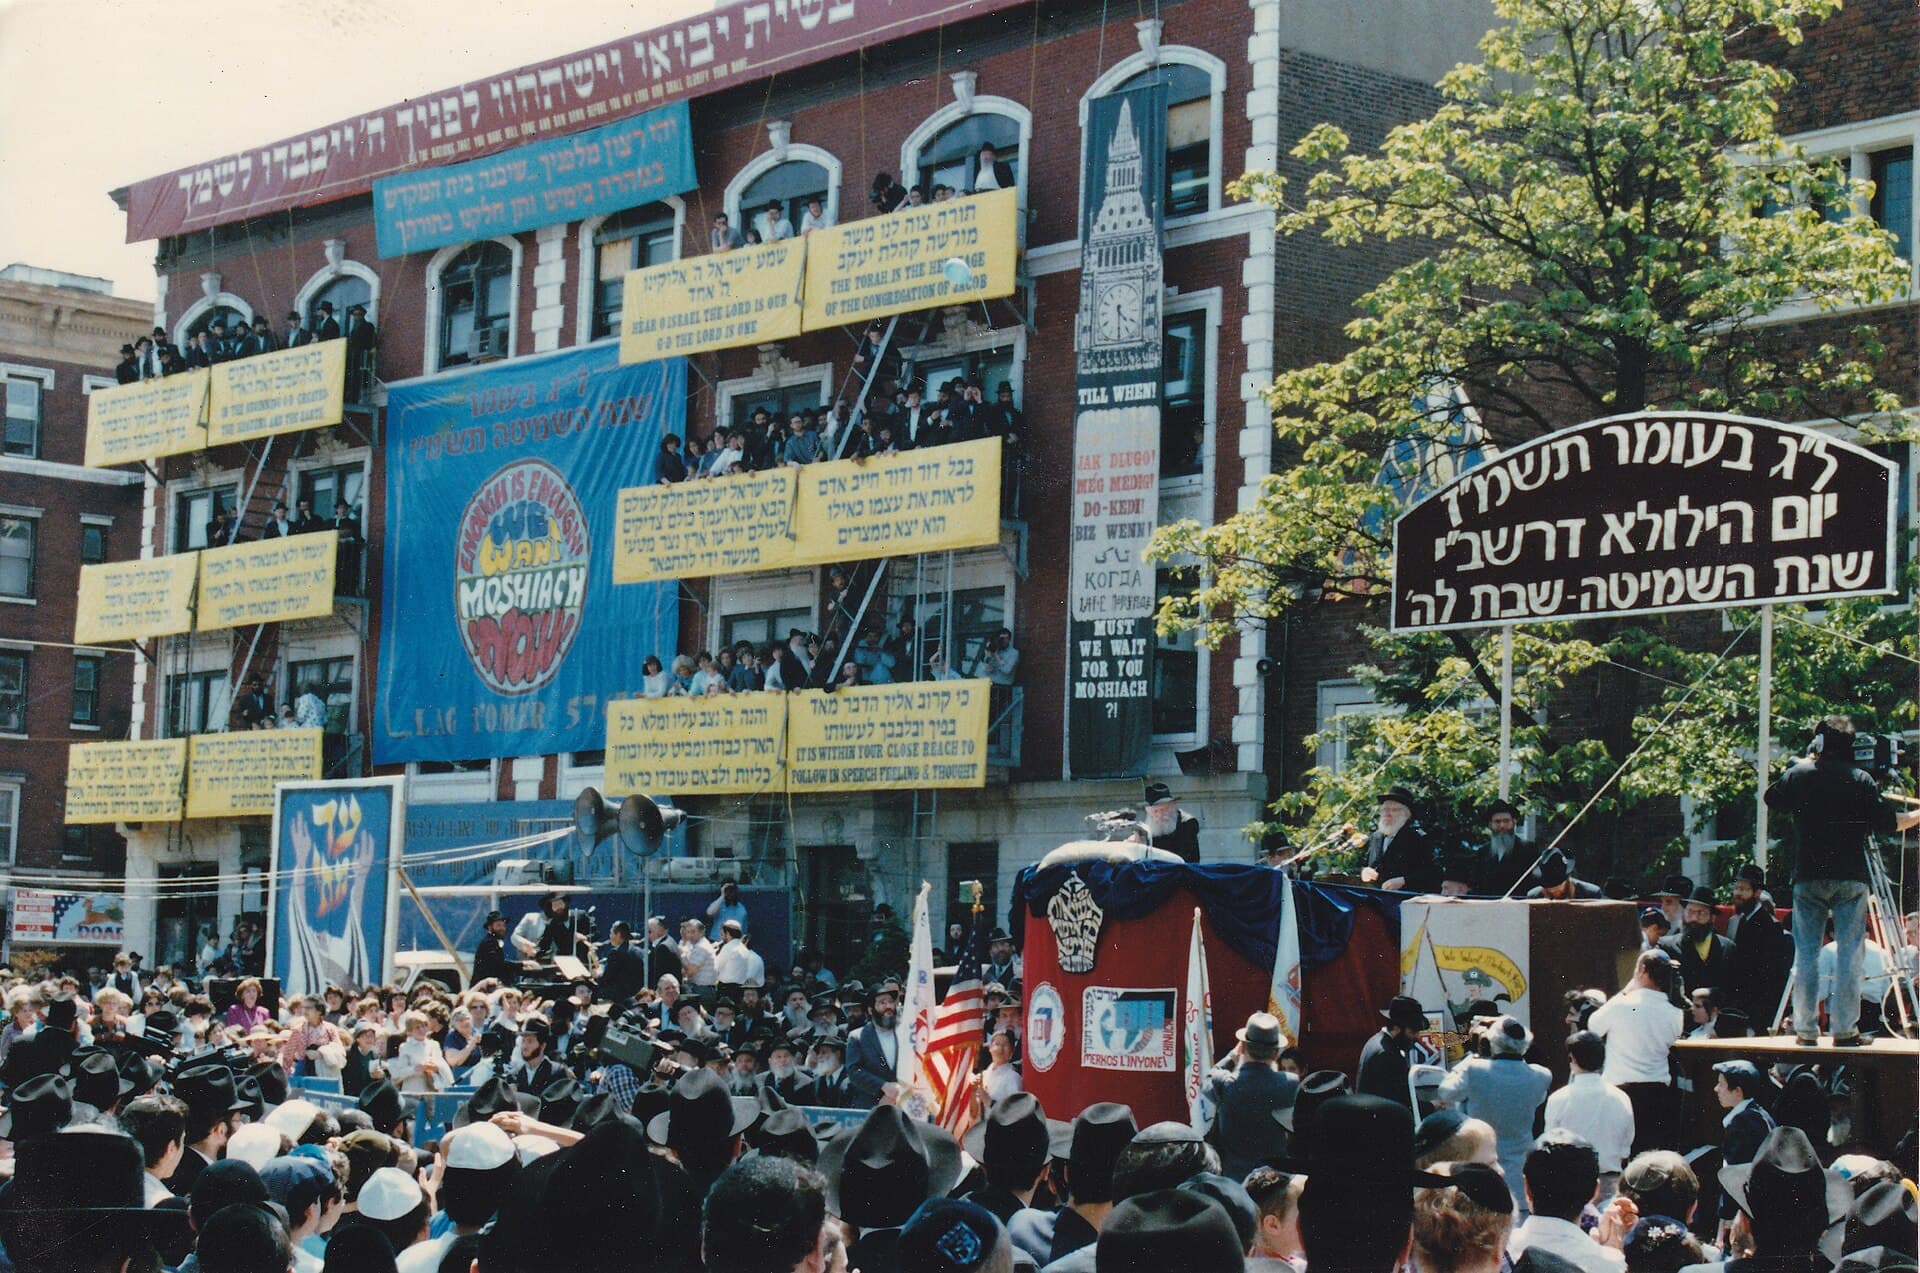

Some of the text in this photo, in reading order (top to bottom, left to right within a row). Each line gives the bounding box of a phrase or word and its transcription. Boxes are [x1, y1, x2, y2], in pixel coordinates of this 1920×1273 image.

[632, 15, 730, 80] יבואו
[489, 48, 625, 118] וישתחוו
[396, 83, 480, 164] לפניך
[261, 124, 355, 186] ויכבדו
[178, 150, 253, 220] לשמך
[842, 204, 977, 249] תורה צוה לנו משה
[926, 227, 979, 252] מורשה
[756, 246, 789, 270] שמע
[830, 251, 985, 295] THE TORAH IS THE HEAGE
[836, 249, 873, 273] יעקב
[631, 318, 657, 335] HEAR
[666, 310, 701, 329] ISRAEL
[703, 305, 723, 322] THE
[725, 300, 751, 319] LORD
[754, 298, 765, 313] IS
[767, 293, 788, 310] OUR
[825, 302, 838, 317] OF
[841, 297, 860, 314] THE
[863, 283, 935, 310] CONGREGATION
[937, 280, 950, 296] OF
[675, 331, 694, 348] THE
[696, 326, 722, 344] LORD
[725, 325, 735, 339] IS
[737, 320, 758, 336] ONE
[1078, 381, 1158, 405] TILL WHEN!
[1601, 420, 1755, 472] בעומר
[818, 455, 974, 497] בכל דור ודור חייב אדם
[1078, 453, 1102, 471] JAK
[868, 494, 904, 517] עצמו
[906, 491, 929, 511] את
[930, 480, 975, 508] לראות
[461, 478, 508, 574] ENOUGH
[510, 470, 526, 501] IS
[489, 500, 549, 546] WE
[837, 515, 946, 546] הוא יצא ממצרים
[1074, 521, 1153, 542] BIZ WENN!
[1599, 494, 1754, 557] הילולא
[1770, 492, 1839, 544] יום
[1773, 549, 1875, 596] שנת
[460, 563, 587, 619] MOSHIACH
[1405, 578, 1458, 626] לה'
[1093, 619, 1136, 637] MUST
[1079, 638, 1147, 657] WE WAIT
[1081, 659, 1144, 679] FOR YOU
[810, 689, 970, 716] כי קרוב אליך הדבר מאד
[1075, 680, 1148, 699] MOSHIACH
[413, 705, 458, 737] LAG
[739, 707, 768, 726] והנה
[796, 739, 975, 763] IT IS WITHIN YOUR CLOSE REACH TO
[791, 767, 828, 785] FOLLOW
[829, 767, 840, 783] IN
[842, 766, 878, 783] SPEECH
[879, 765, 920, 782] FEELING
[932, 763, 978, 780] THOUGHT
[1083, 1053, 1119, 1068] MERKOS
